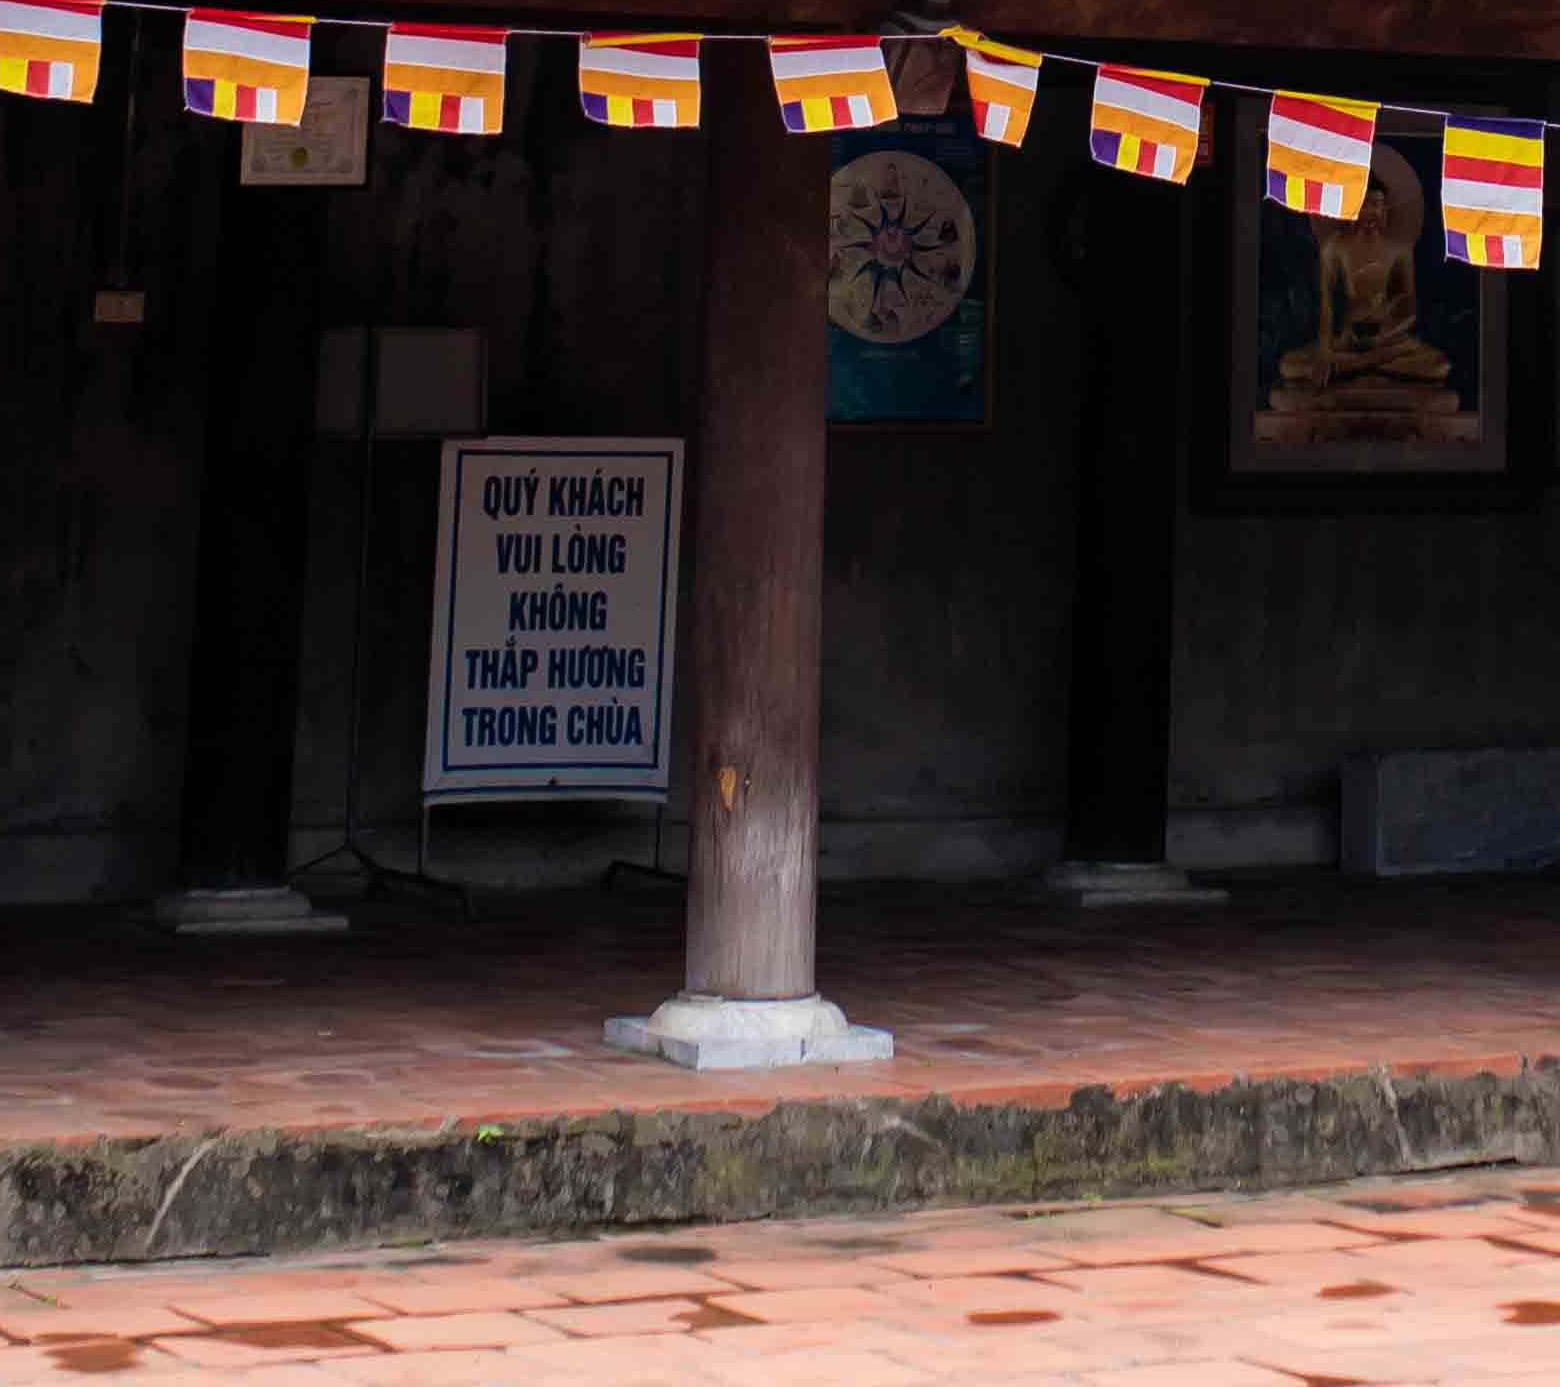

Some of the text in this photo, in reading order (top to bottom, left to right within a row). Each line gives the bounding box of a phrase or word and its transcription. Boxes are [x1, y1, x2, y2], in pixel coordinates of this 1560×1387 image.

[482, 469, 645, 520] QUÝ KHÁCH
[496, 524, 626, 574] VUI LÒNG
[509, 584, 608, 631] KHÔNG
[465, 637, 646, 690] THẮP HƯƠNG
[462, 698, 643, 747] TRONG CHÙA
